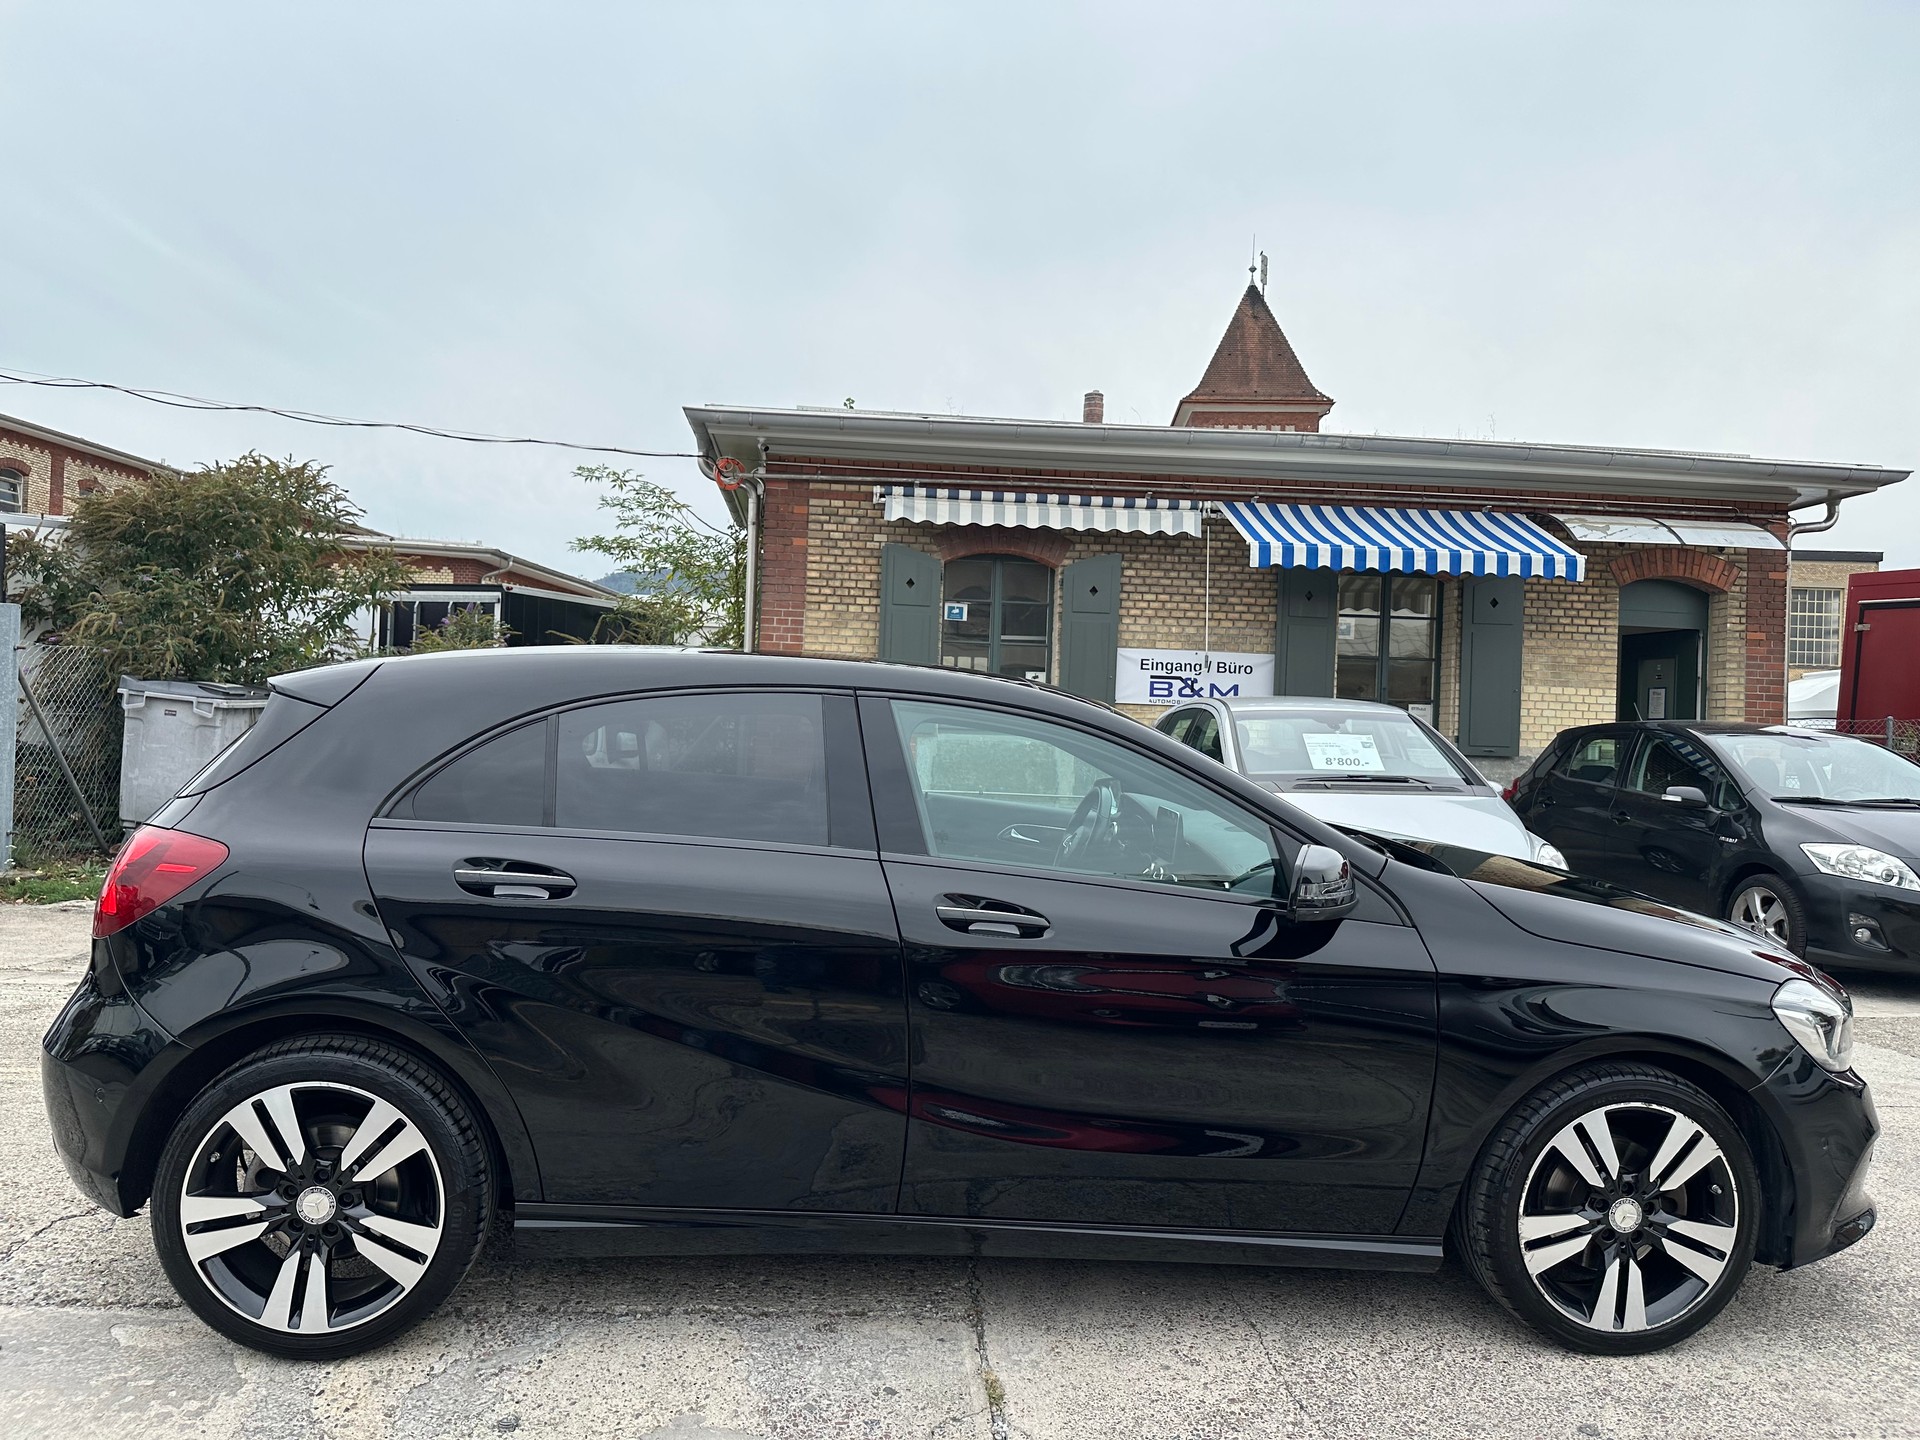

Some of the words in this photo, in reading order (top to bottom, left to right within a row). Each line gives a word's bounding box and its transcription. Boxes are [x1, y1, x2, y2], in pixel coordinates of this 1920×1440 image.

[1140, 658, 1203, 675] Eingang
[1217, 661, 1253, 675] Büro
[1149, 677, 1239, 698] B&M
